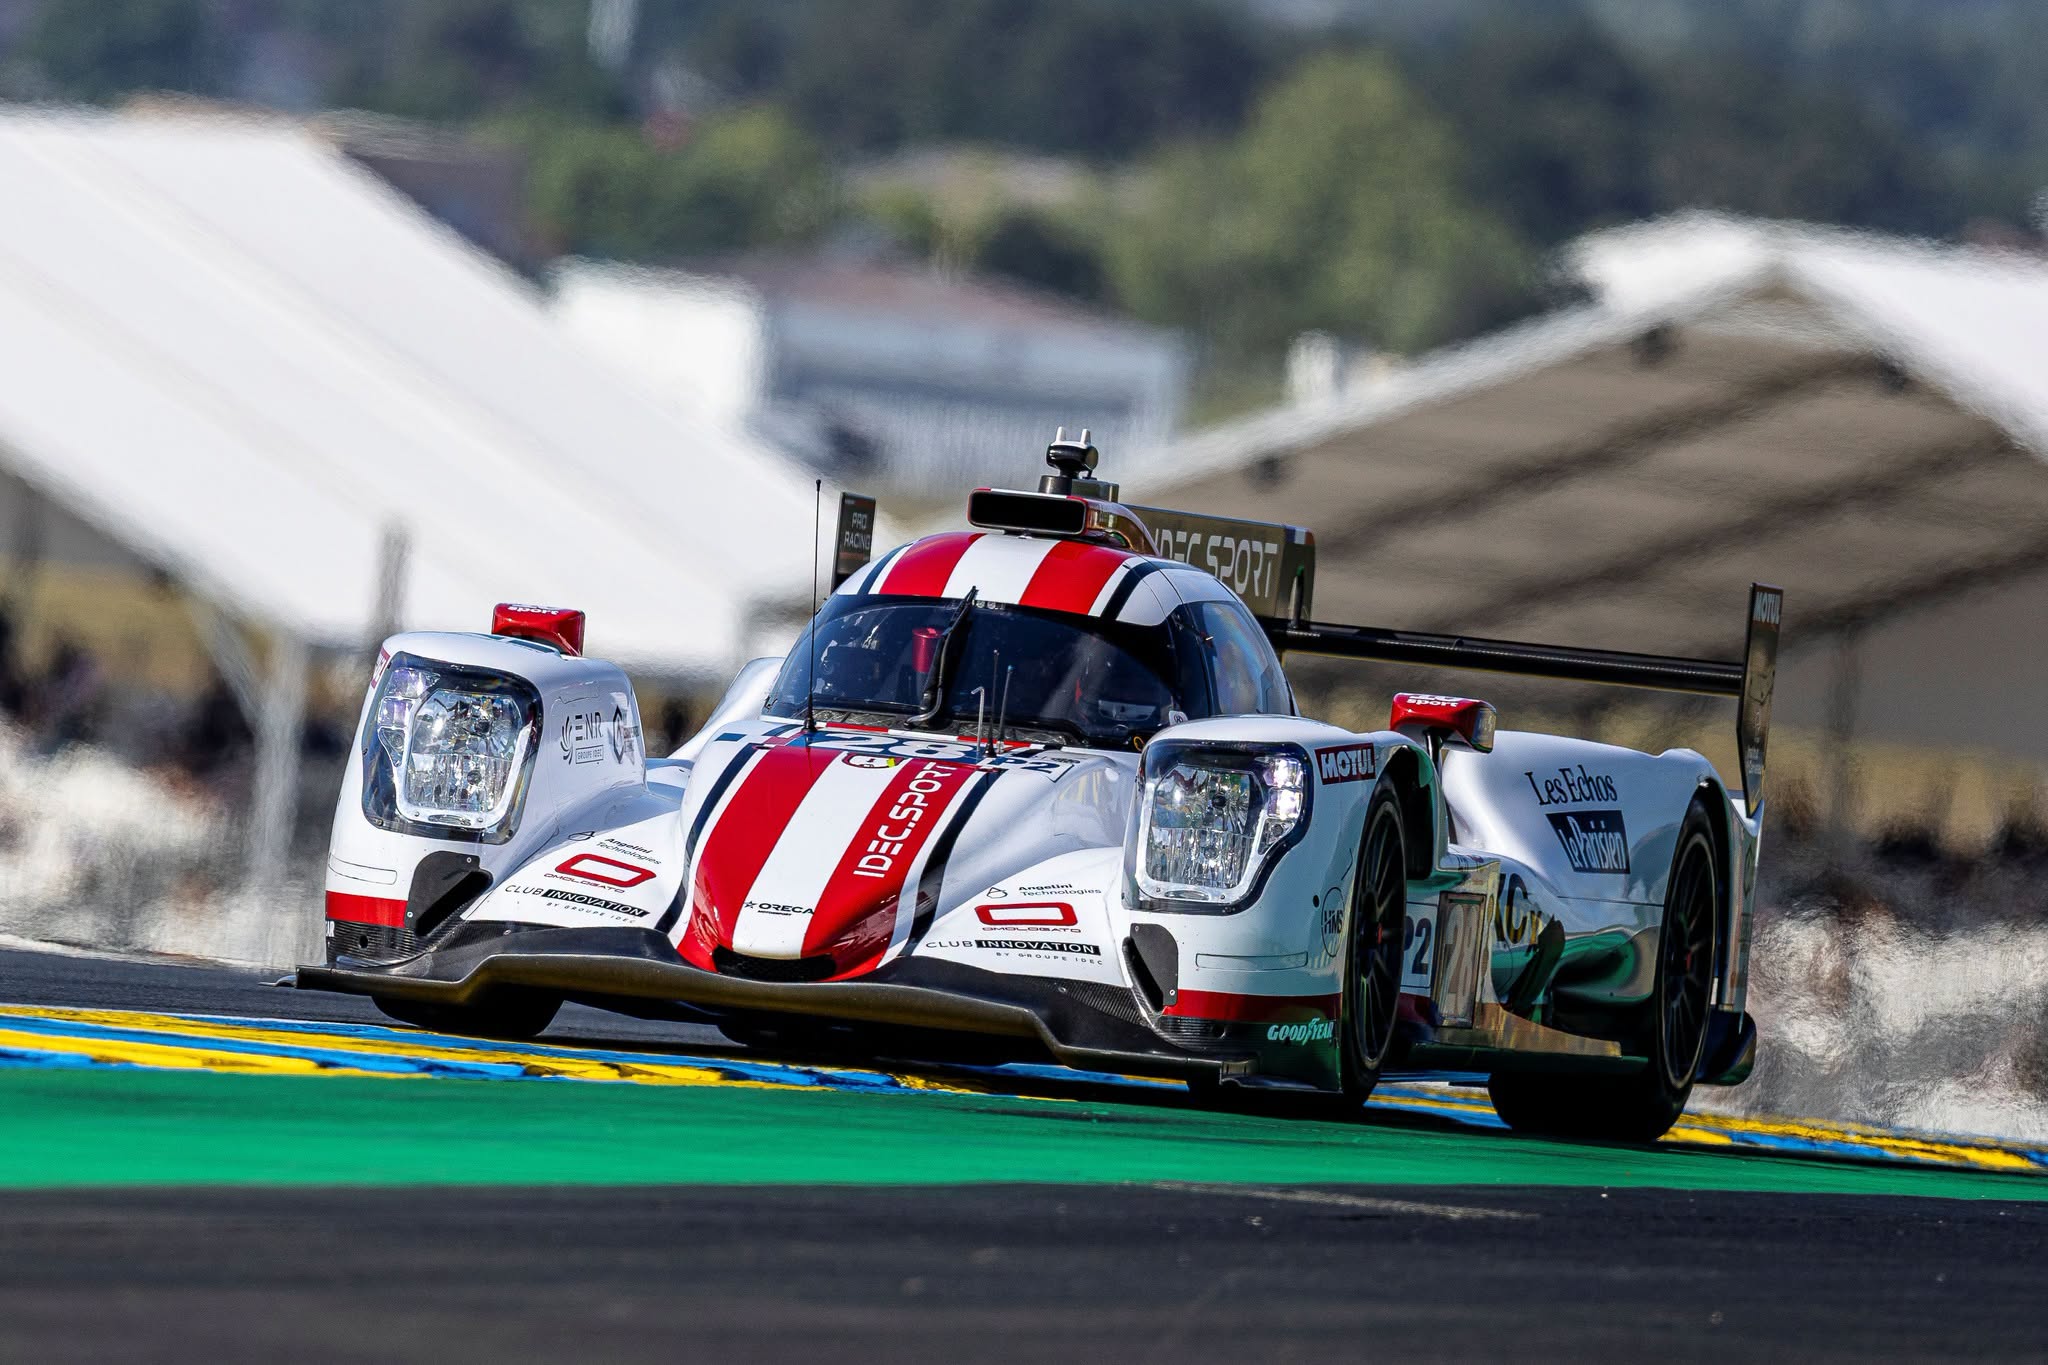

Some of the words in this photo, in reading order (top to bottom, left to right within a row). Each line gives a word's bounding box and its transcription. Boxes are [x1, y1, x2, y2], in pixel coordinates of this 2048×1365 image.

[851, 512, 867, 529] PRO
[844, 531, 871, 550] RACING
[1206, 535, 1278, 599] SPORT
[1753, 591, 1781, 625] MOTUL
[1406, 698, 1459, 708] sport
[808, 733, 974, 759] 28
[987, 756, 1060, 774] P2
[1320, 748, 1375, 779] MOTUL
[1524, 771, 1568, 805] Les
[1558, 764, 1618, 803] Echos
[596, 842, 662, 865] Technologies
[605, 837, 654, 855] Angelini
[544, 873, 625, 894] OMOLOGATO
[1018, 883, 1072, 891] Angelini
[1022, 888, 1102, 896] Technologies
[505, 884, 544, 896] CLUB
[549, 890, 643, 917] INNOVATION
[758, 902, 815, 915] ORECA
[564, 905, 606, 916] GROUPE
[610, 915, 636, 924] IDEC
[981, 941, 1094, 954] INNOVATION
[1018, 953, 1067, 961] GROUPE
[1446, 903, 1479, 1017] 28
[1267, 1018, 1335, 1045] GOODYEAR
